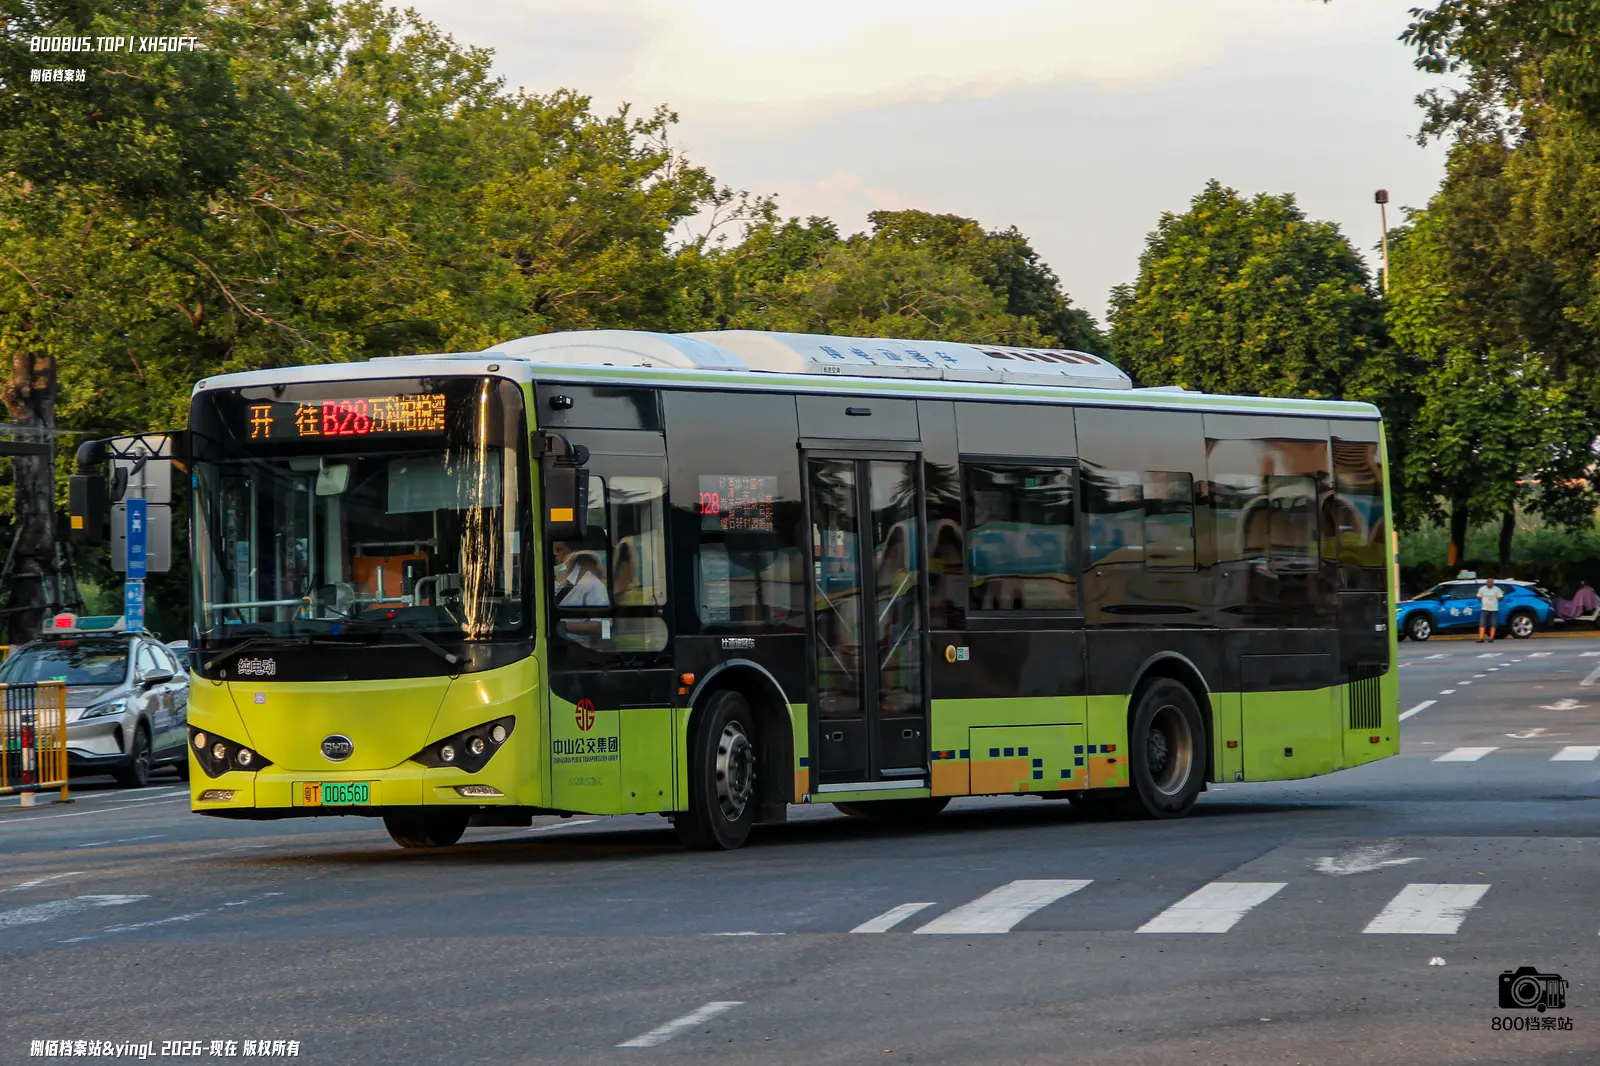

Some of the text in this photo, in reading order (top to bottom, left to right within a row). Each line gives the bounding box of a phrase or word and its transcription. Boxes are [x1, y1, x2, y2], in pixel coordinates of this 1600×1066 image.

[321, 399, 369, 436] B28
[237, 658, 276, 675] 纯电动
[323, 741, 350, 754] BYD
[553, 737, 618, 754] 中山公交集团
